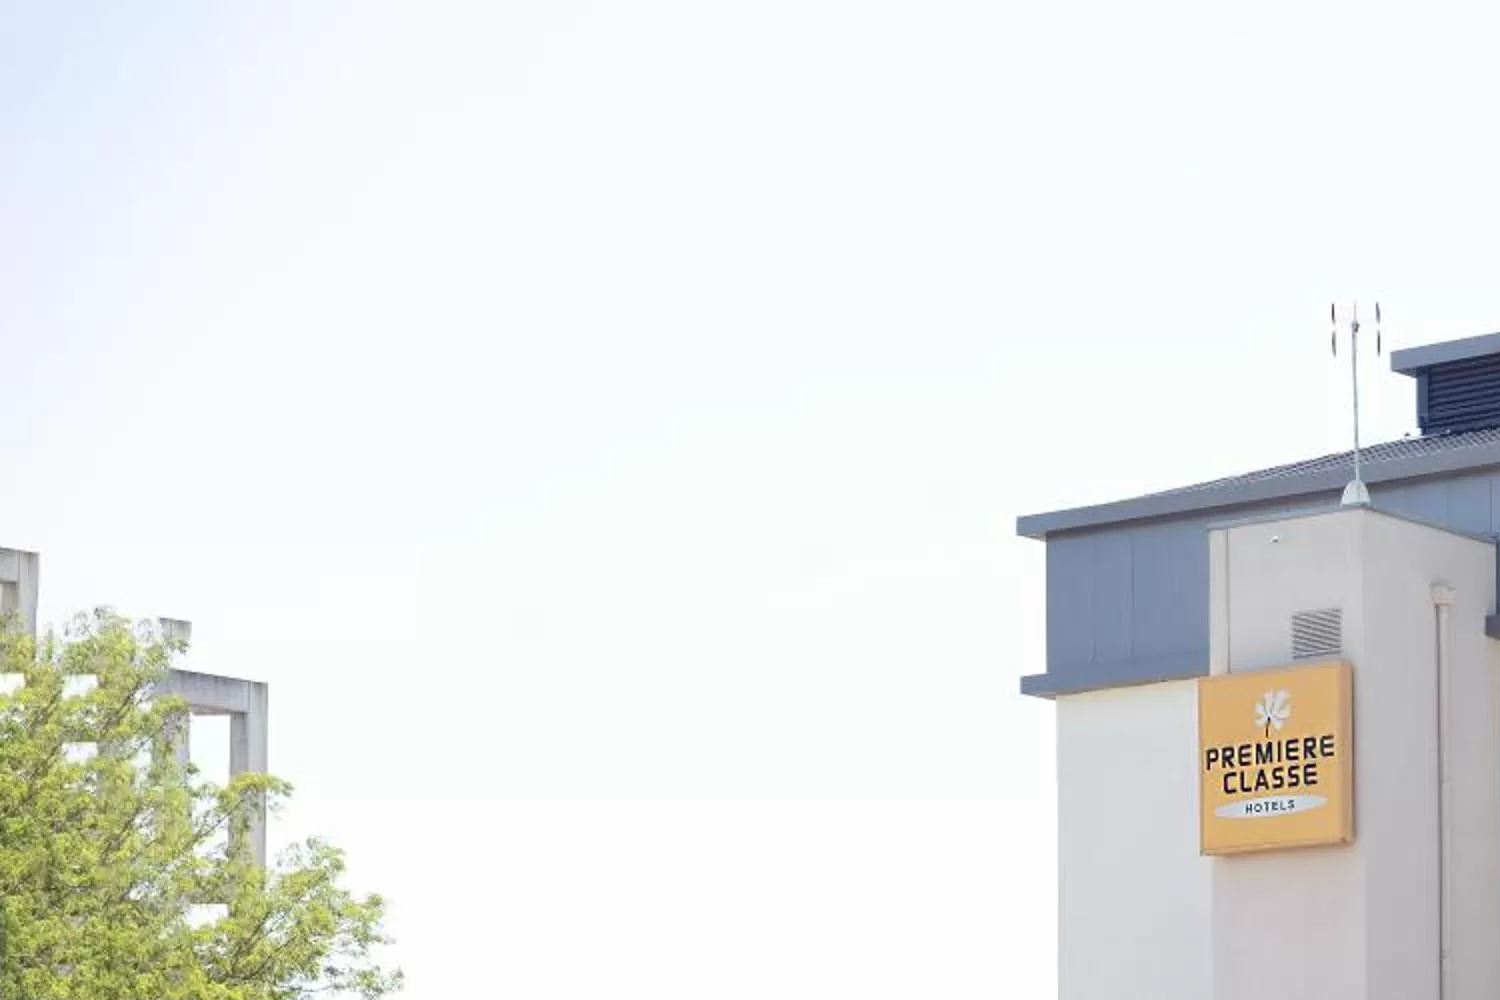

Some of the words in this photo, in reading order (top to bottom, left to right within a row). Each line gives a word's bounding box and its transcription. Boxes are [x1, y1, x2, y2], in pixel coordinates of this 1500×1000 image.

[1206, 735, 1335, 771] PREMIERE
[1223, 763, 1318, 795] CLASSE
[1245, 799, 1295, 814] HOTELS
